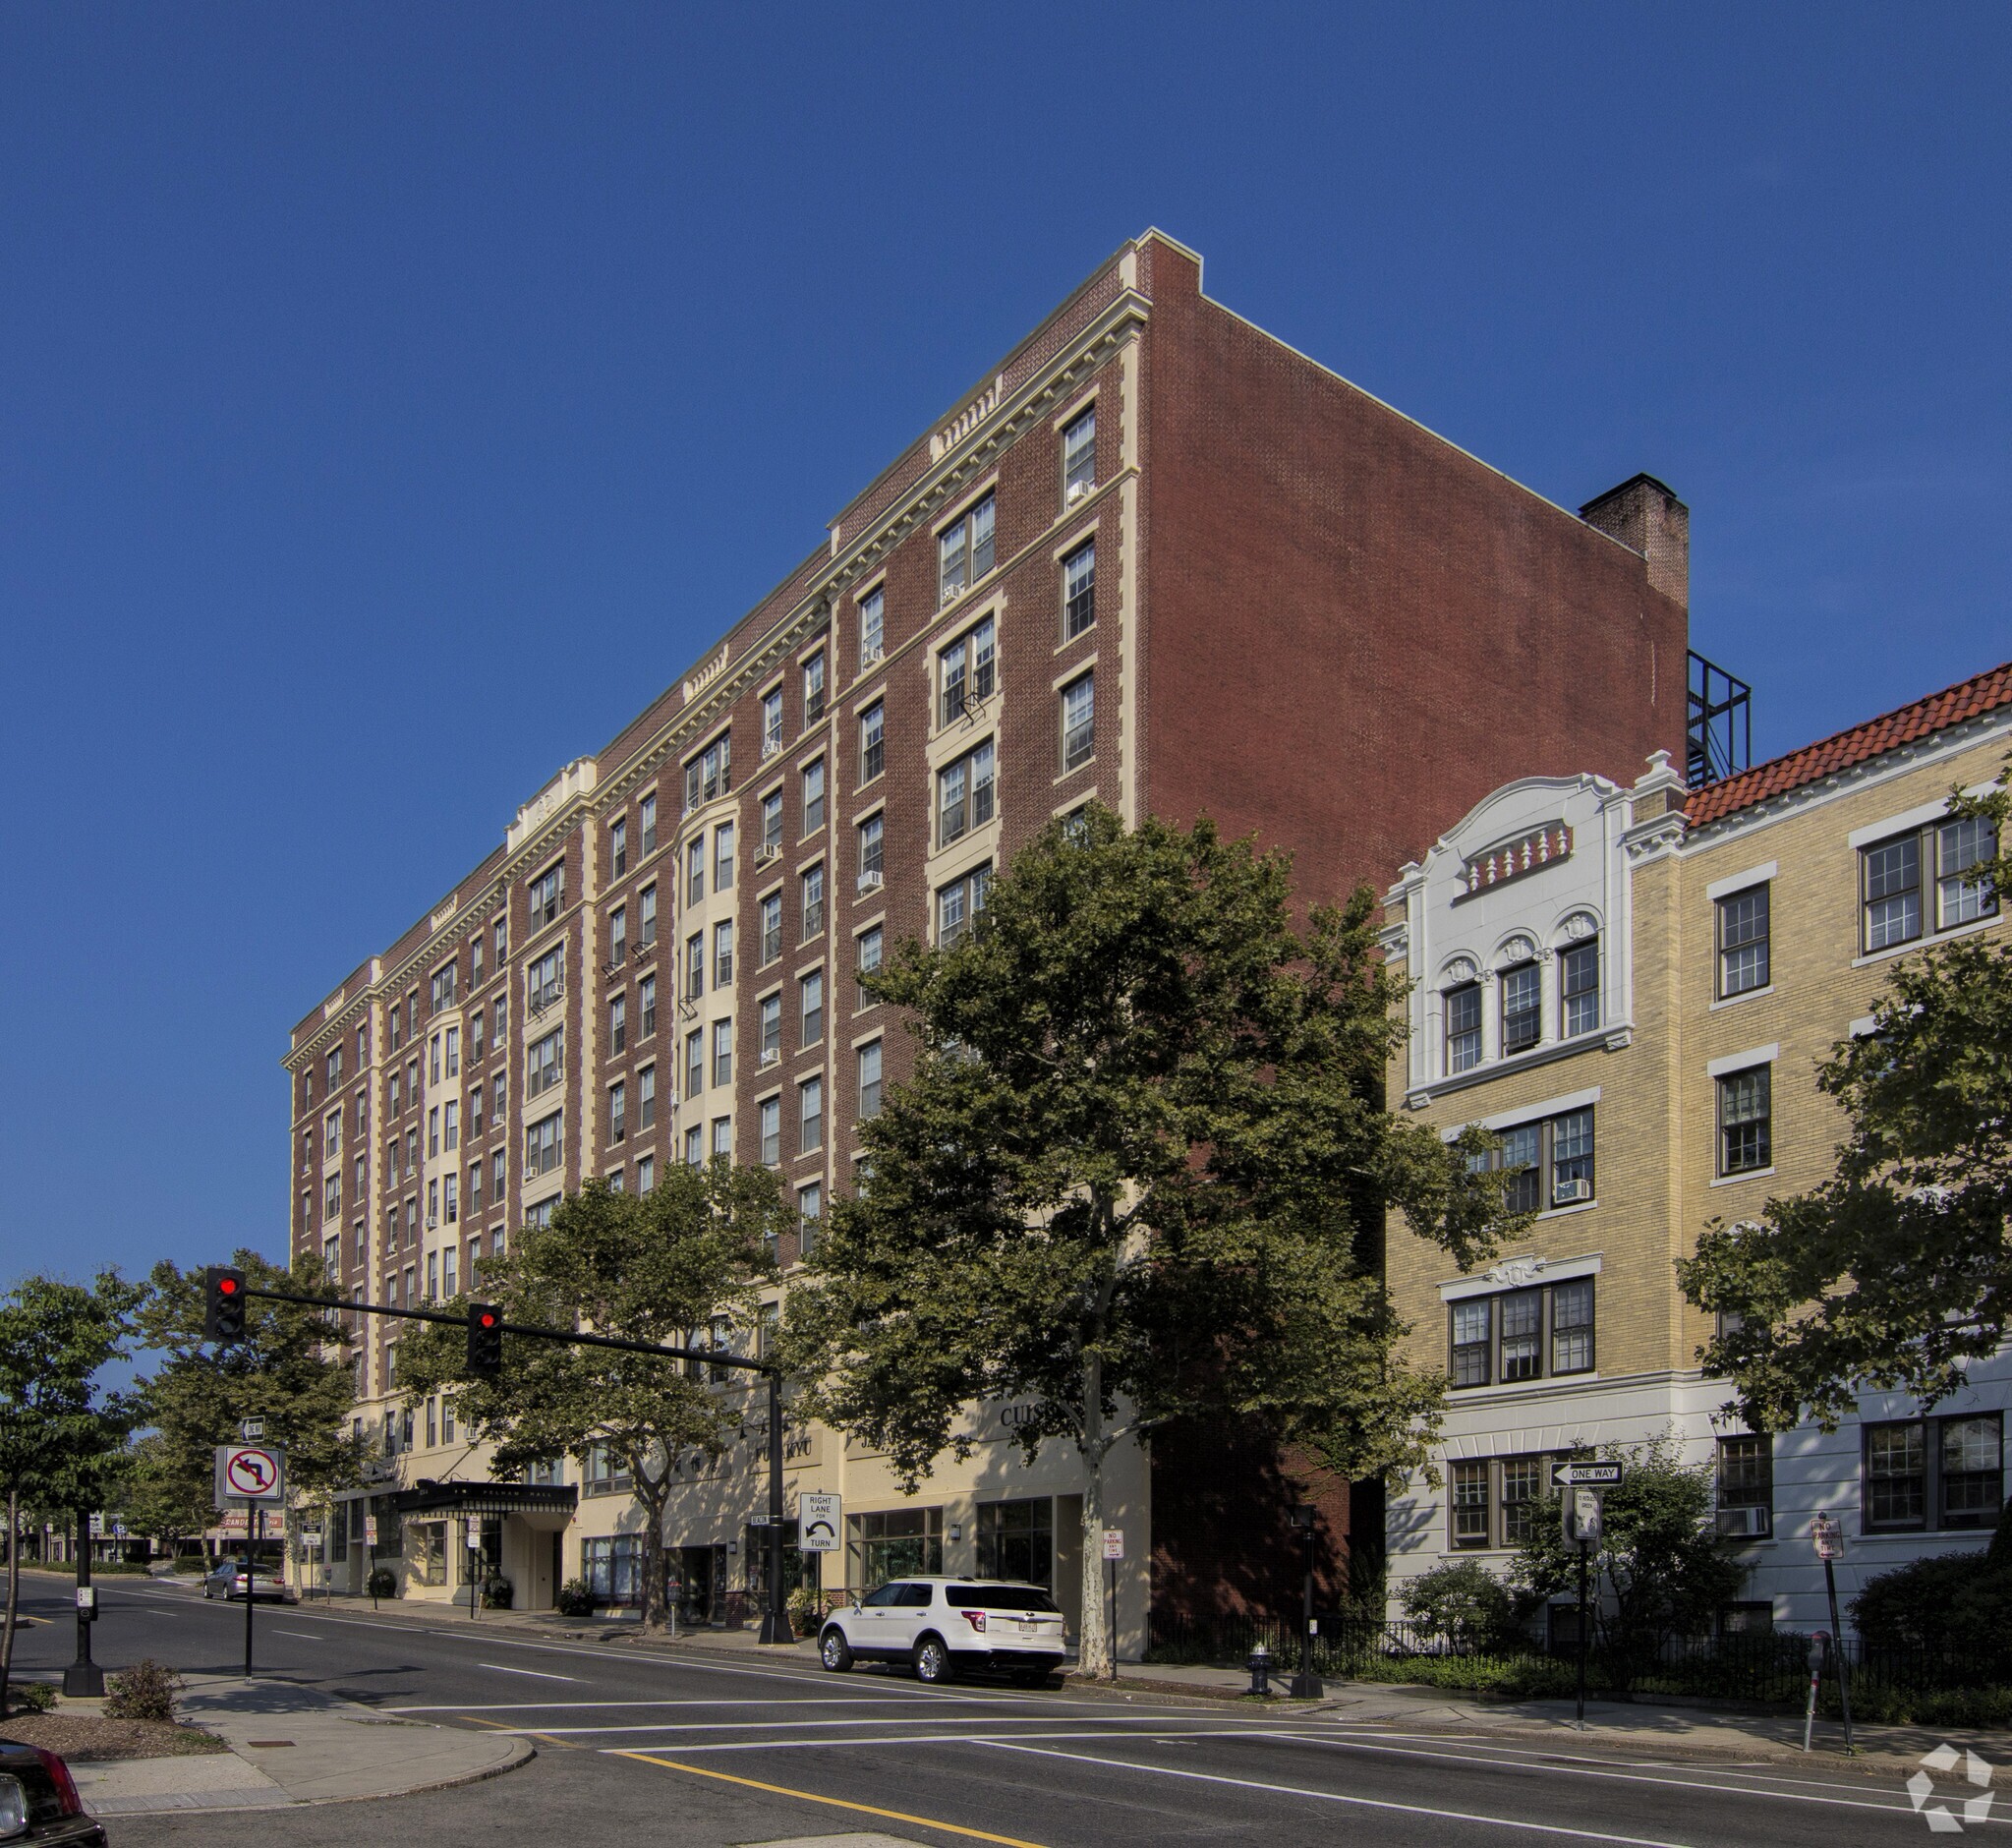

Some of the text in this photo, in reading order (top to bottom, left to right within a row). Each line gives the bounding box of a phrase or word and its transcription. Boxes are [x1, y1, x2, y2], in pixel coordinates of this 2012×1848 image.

[755, 1439, 812, 1463] FUKYU
[1572, 1469, 1615, 1478] ONE WAY
[221, 1518, 249, 1527] RANDE
[1813, 1531, 1841, 1540] PARKING
